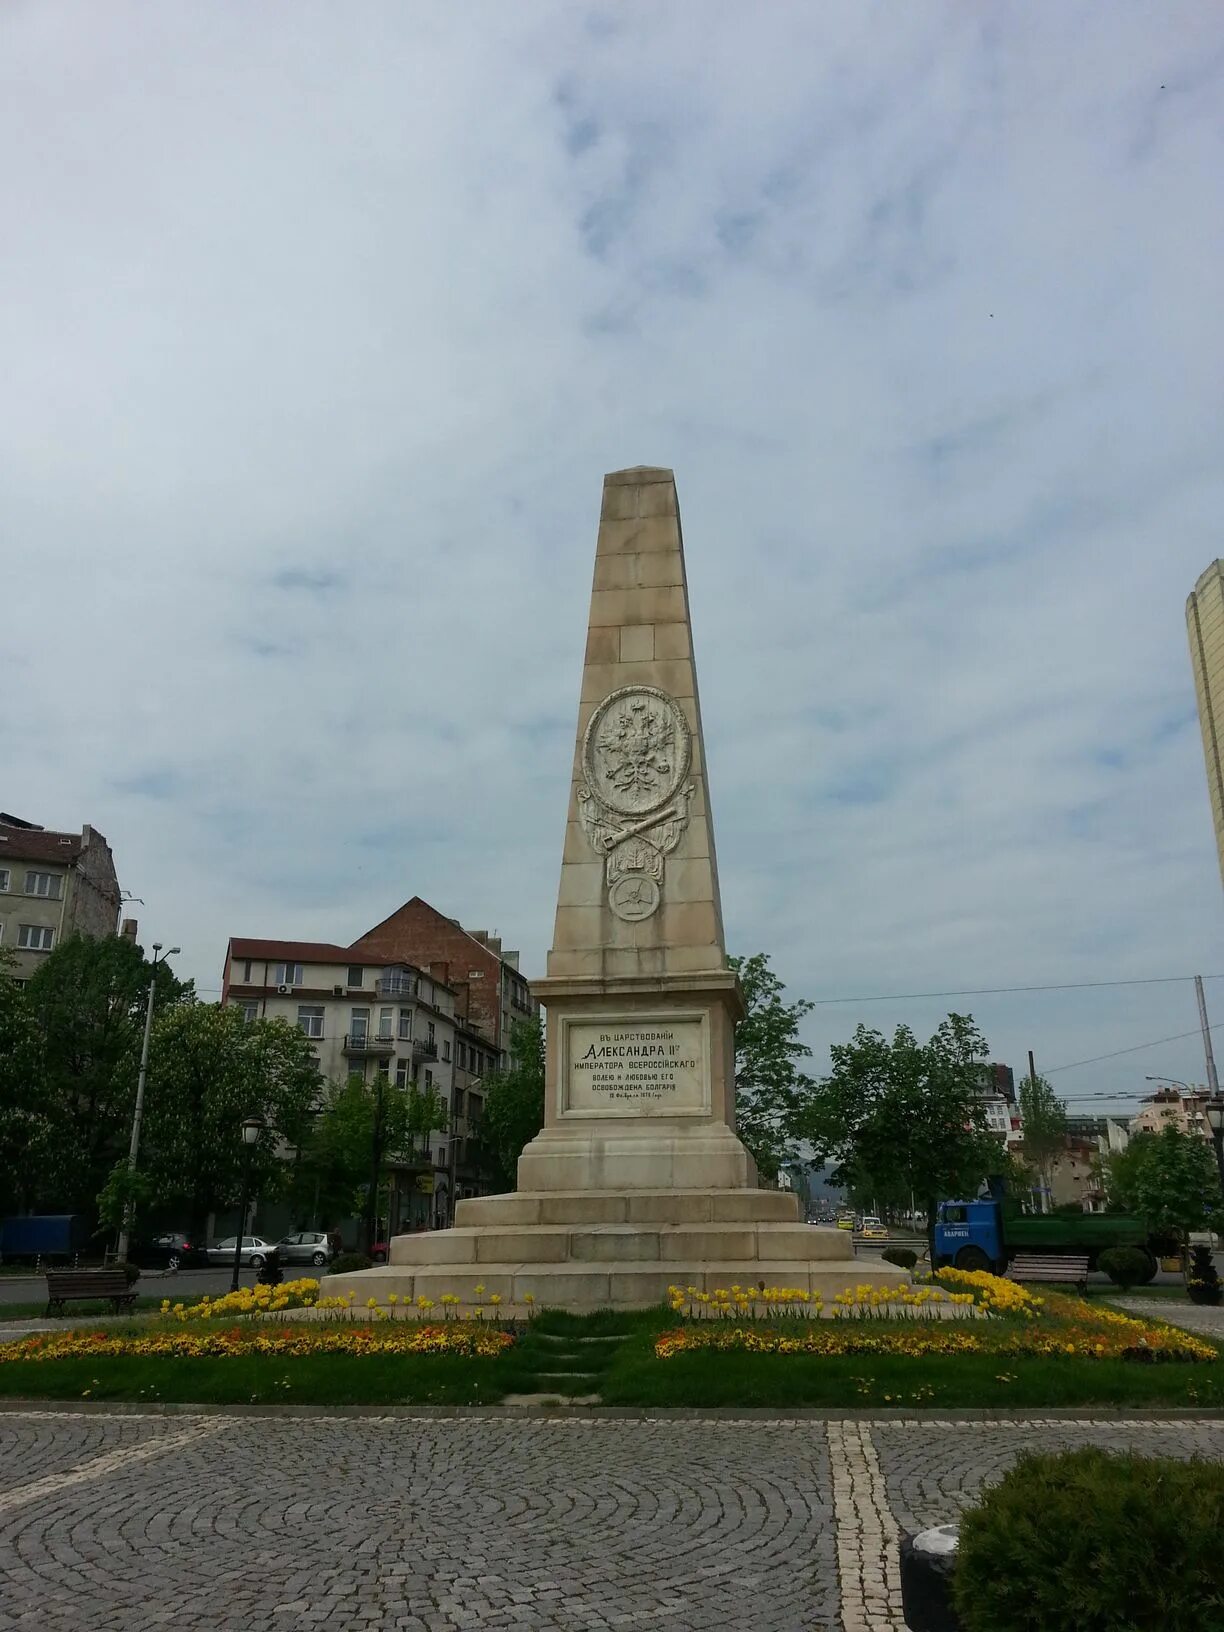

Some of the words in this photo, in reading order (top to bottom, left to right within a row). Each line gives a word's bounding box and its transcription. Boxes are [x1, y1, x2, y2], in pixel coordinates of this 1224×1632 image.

[600, 1034, 611, 1042] ВЪ
[574, 1062, 624, 1070] ИМПЕРАТОРА
[625, 1073, 658, 1081] ЛЮБОВЬЮ
